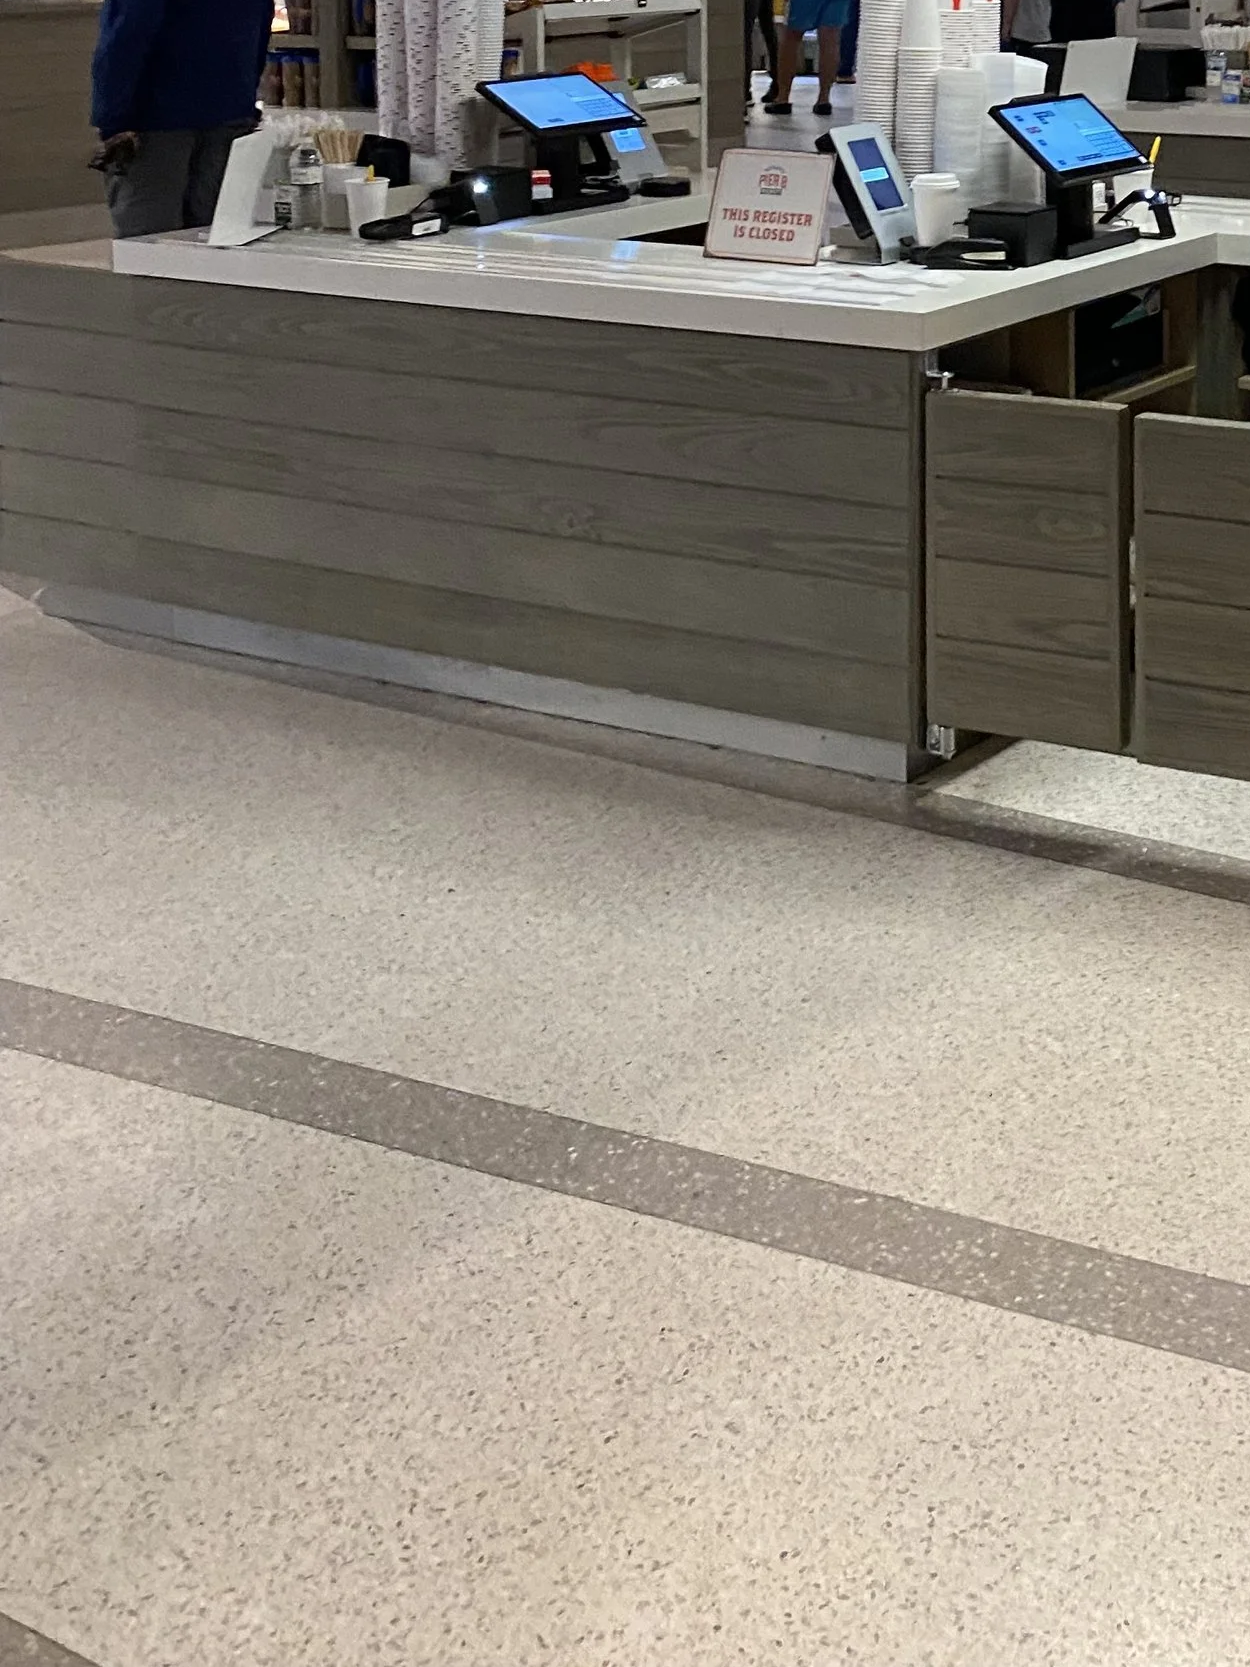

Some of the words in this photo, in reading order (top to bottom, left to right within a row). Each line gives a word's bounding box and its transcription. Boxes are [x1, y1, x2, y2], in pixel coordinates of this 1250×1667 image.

[723, 208, 749, 222] THIS
[753, 210, 812, 226] REGISTER
[733, 224, 745, 238] IS
[748, 226, 795, 242] CLOSED
